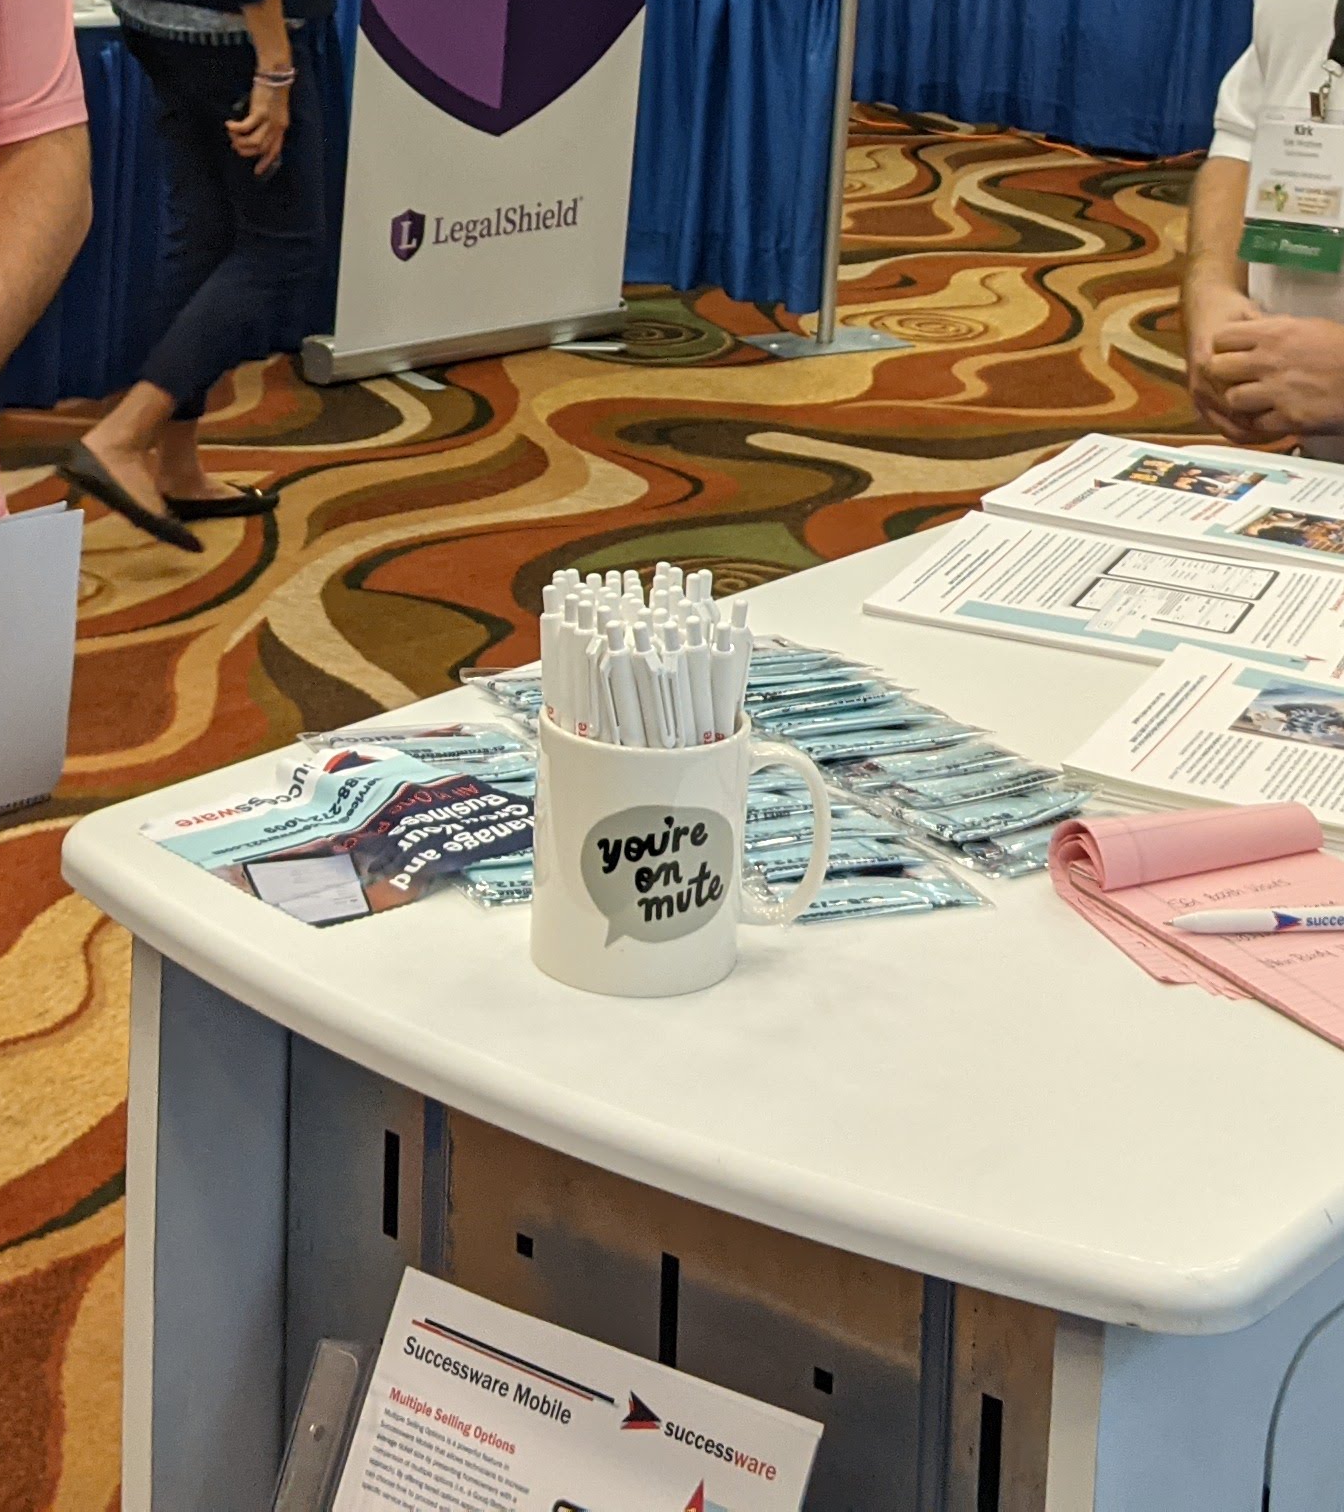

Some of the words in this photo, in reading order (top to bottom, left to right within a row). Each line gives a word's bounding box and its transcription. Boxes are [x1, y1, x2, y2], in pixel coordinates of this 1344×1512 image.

[1293, 124, 1314, 138] Kirk
[431, 196, 580, 249] LegalShield
[389, 848, 442, 891] and
[597, 815, 709, 874] you're
[634, 860, 684, 894] on
[637, 861, 724, 922] mute
[403, 1335, 510, 1397] Successware
[512, 1383, 573, 1426] Mobile
[389, 1387, 434, 1418] Multiple
[433, 1407, 471, 1438] Selling
[472, 1424, 517, 1456] Options
[663, 1419, 778, 1481] successware
